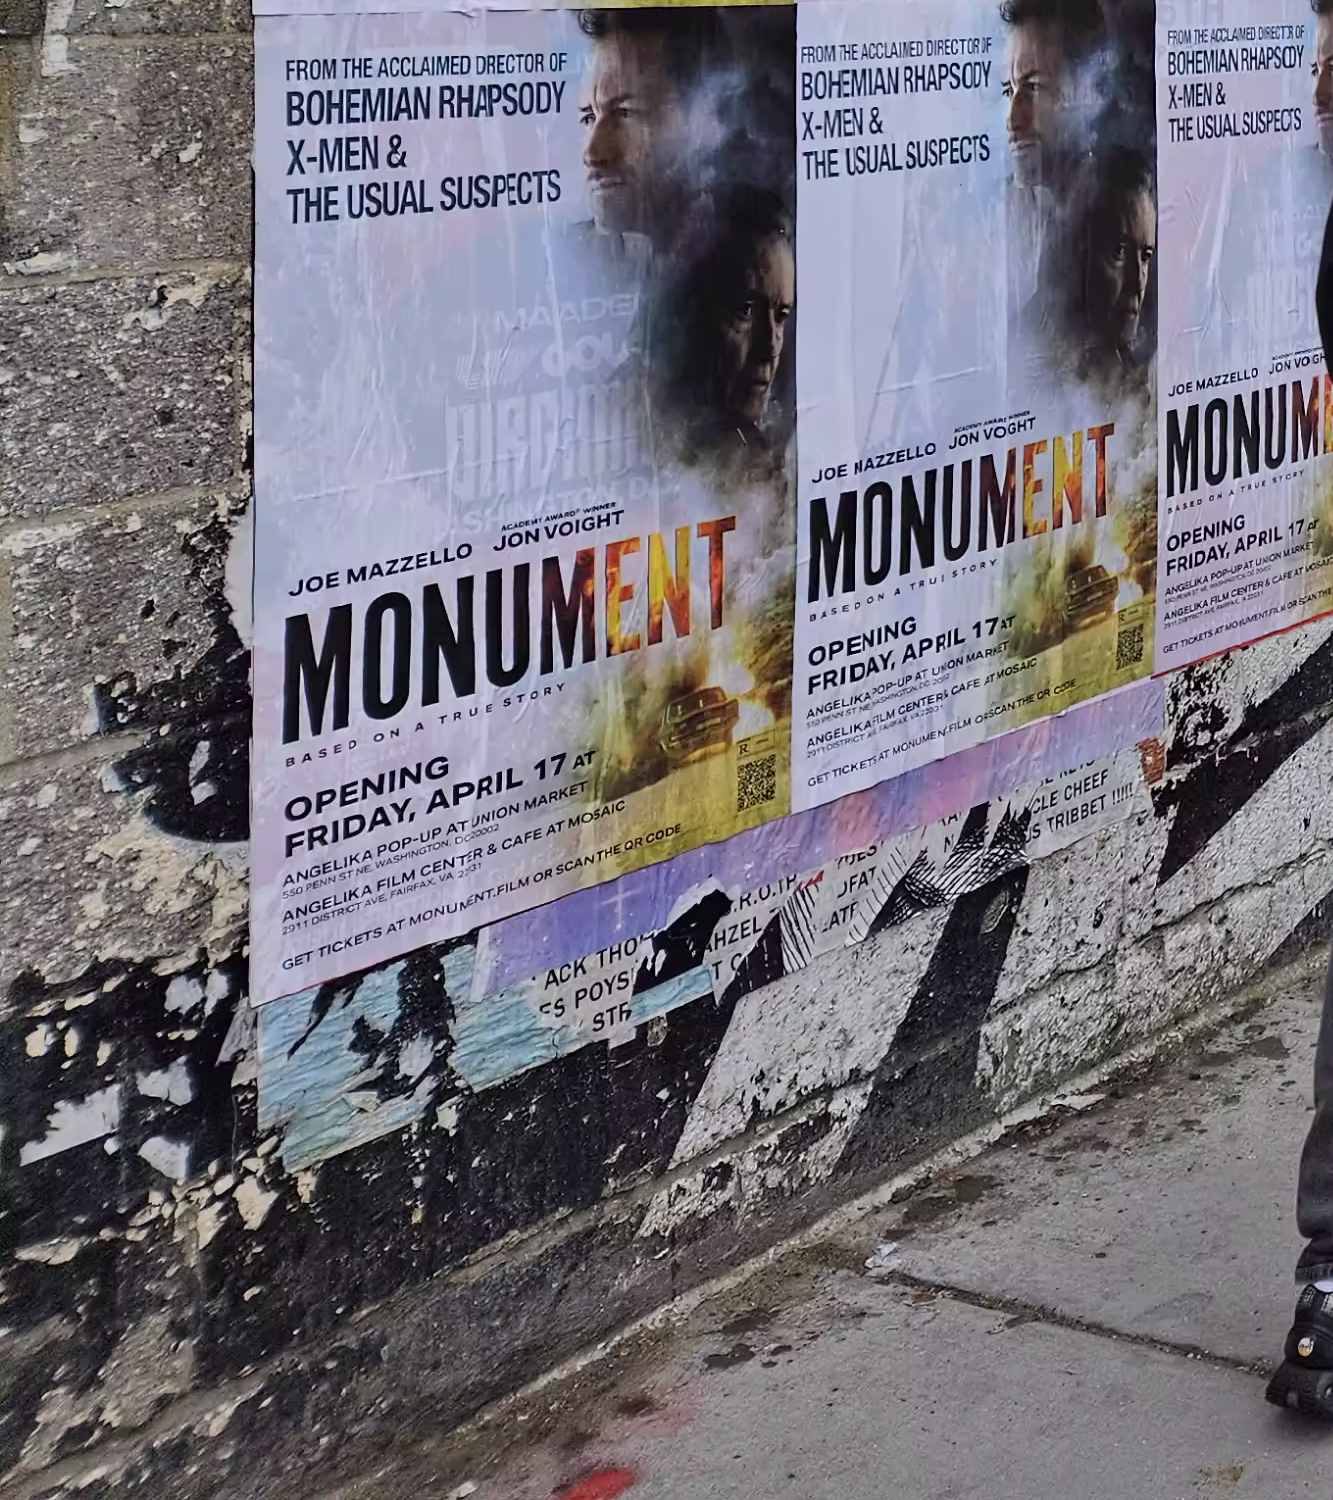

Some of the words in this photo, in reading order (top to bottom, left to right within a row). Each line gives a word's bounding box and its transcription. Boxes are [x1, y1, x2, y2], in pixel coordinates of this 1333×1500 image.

[286, 58, 338, 81] FROM
[343, 58, 373, 79] THE
[377, 55, 471, 78] ACCLAIMED
[475, 54, 542, 75] DRECTOR
[547, 52, 568, 73] OF
[286, 86, 431, 127] BOHEMIAN
[439, 81, 566, 118] RHAPSODY
[286, 135, 378, 176] X-MEN
[386, 134, 407, 169] &
[286, 186, 337, 225] THE
[346, 179, 434, 219] USUAL
[440, 169, 562, 212] SUSPECTS
[808, 422, 1115, 604] MONUMENT
[1166, 514, 1246, 553] OPENING
[288, 570, 339, 598] JOE
[346, 542, 473, 585] MAZZELLO
[493, 528, 540, 553] JON
[543, 509, 625, 541] VOIGHT
[282, 515, 737, 745] MONUMENT
[808, 615, 917, 668] OPENING
[284, 754, 450, 823] OPENING
[284, 795, 416, 859] FRIDAY,
[426, 769, 524, 814] APRIL
[533, 752, 567, 782] 17
[573, 750, 599, 771] AT
[1046, 794, 1107, 833] TRIBBET
[544, 956, 588, 991] ACK
